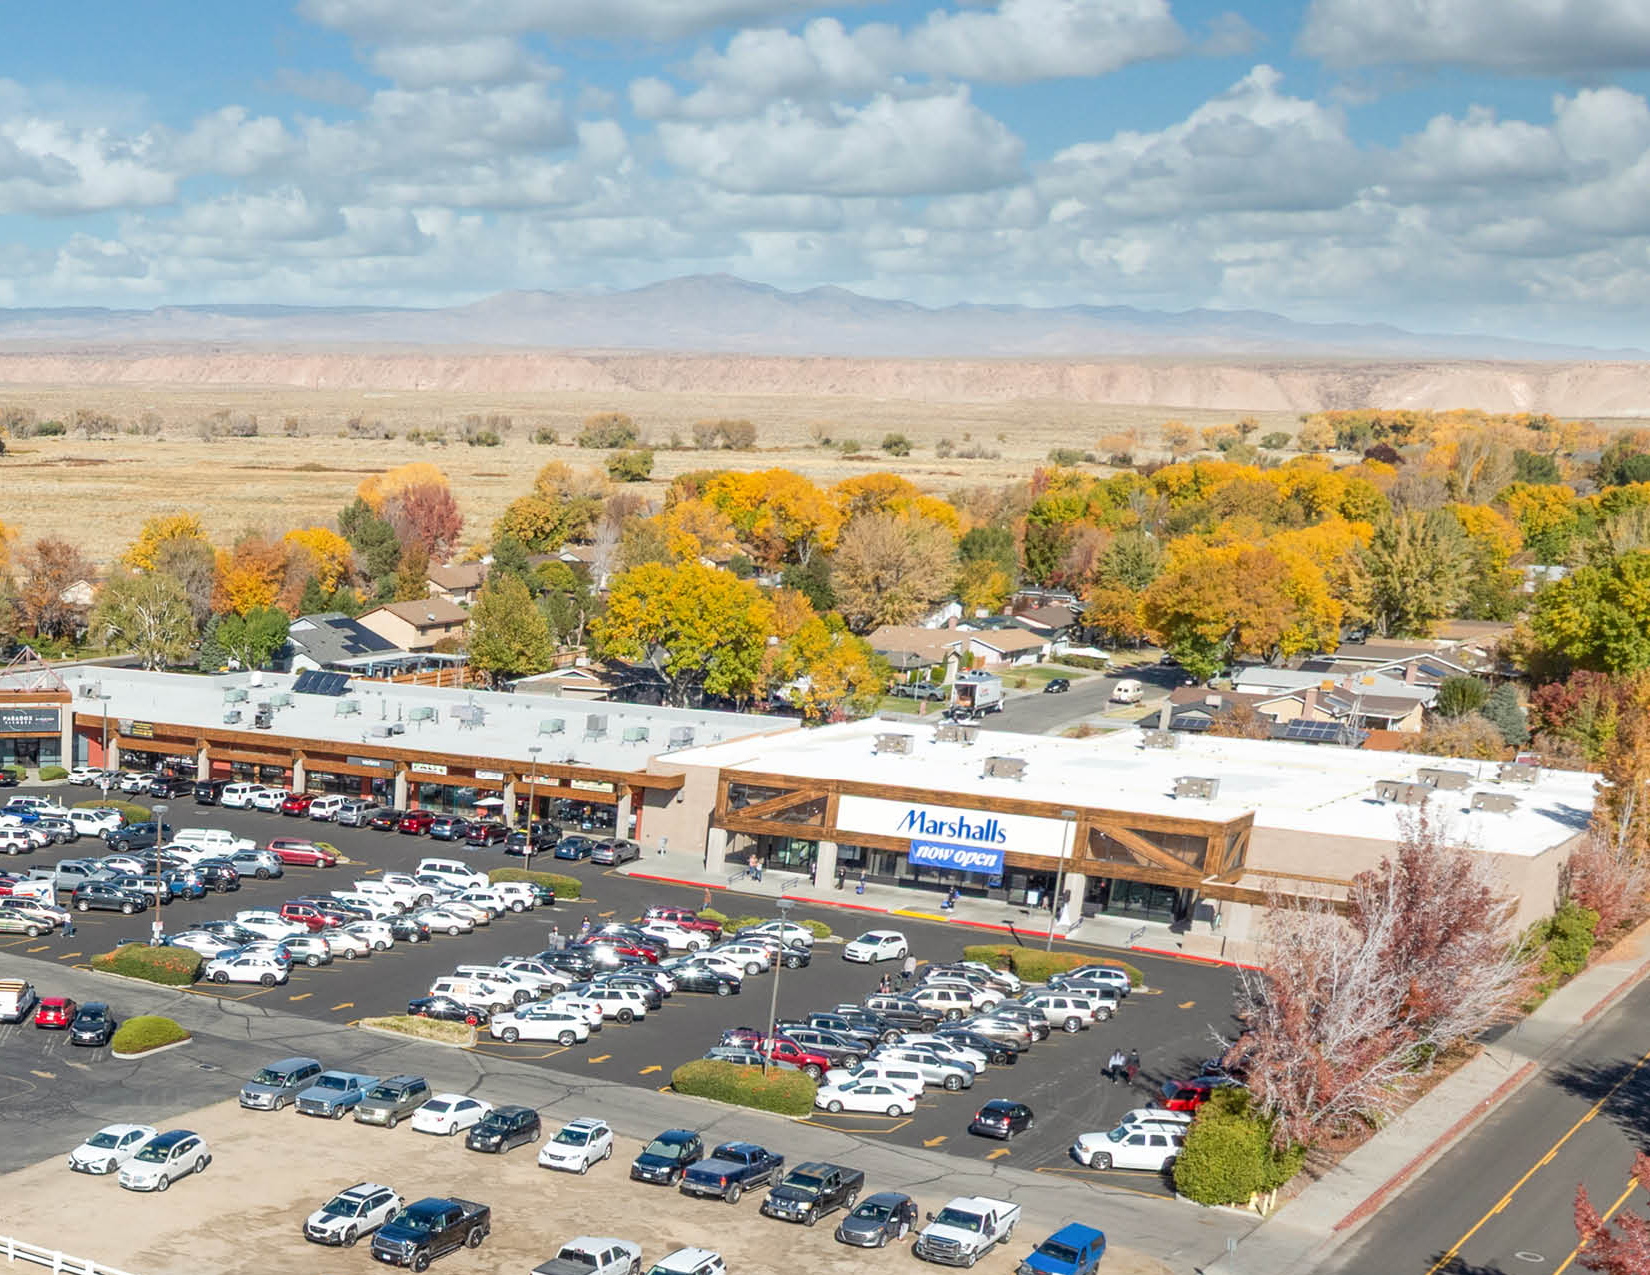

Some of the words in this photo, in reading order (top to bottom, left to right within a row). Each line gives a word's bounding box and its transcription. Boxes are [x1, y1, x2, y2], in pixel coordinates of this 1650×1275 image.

[896, 809, 1007, 844] Marshalls
[915, 846, 954, 861] now
[953, 850, 999, 867] open
